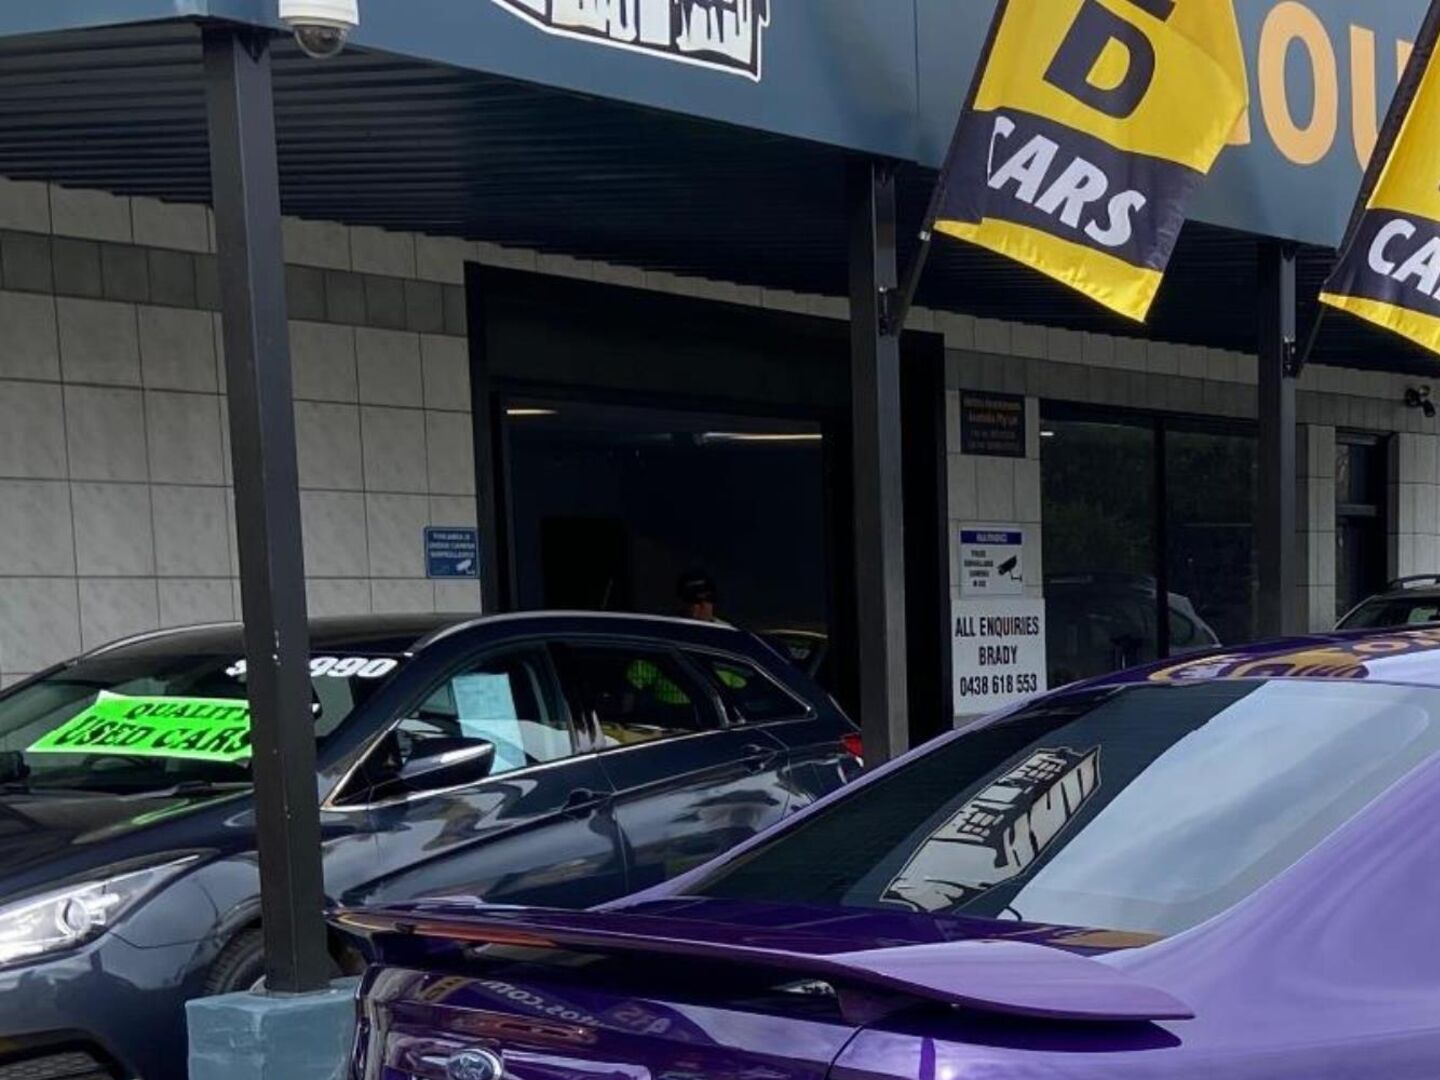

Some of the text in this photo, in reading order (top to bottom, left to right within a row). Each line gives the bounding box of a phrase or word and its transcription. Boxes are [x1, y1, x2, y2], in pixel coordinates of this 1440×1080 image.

[955, 615, 1040, 638] ALL ENQUIRIES
[978, 644, 1018, 666] BRADY
[960, 672, 1038, 697] 0438 618 553
[54, 715, 156, 746] USED
